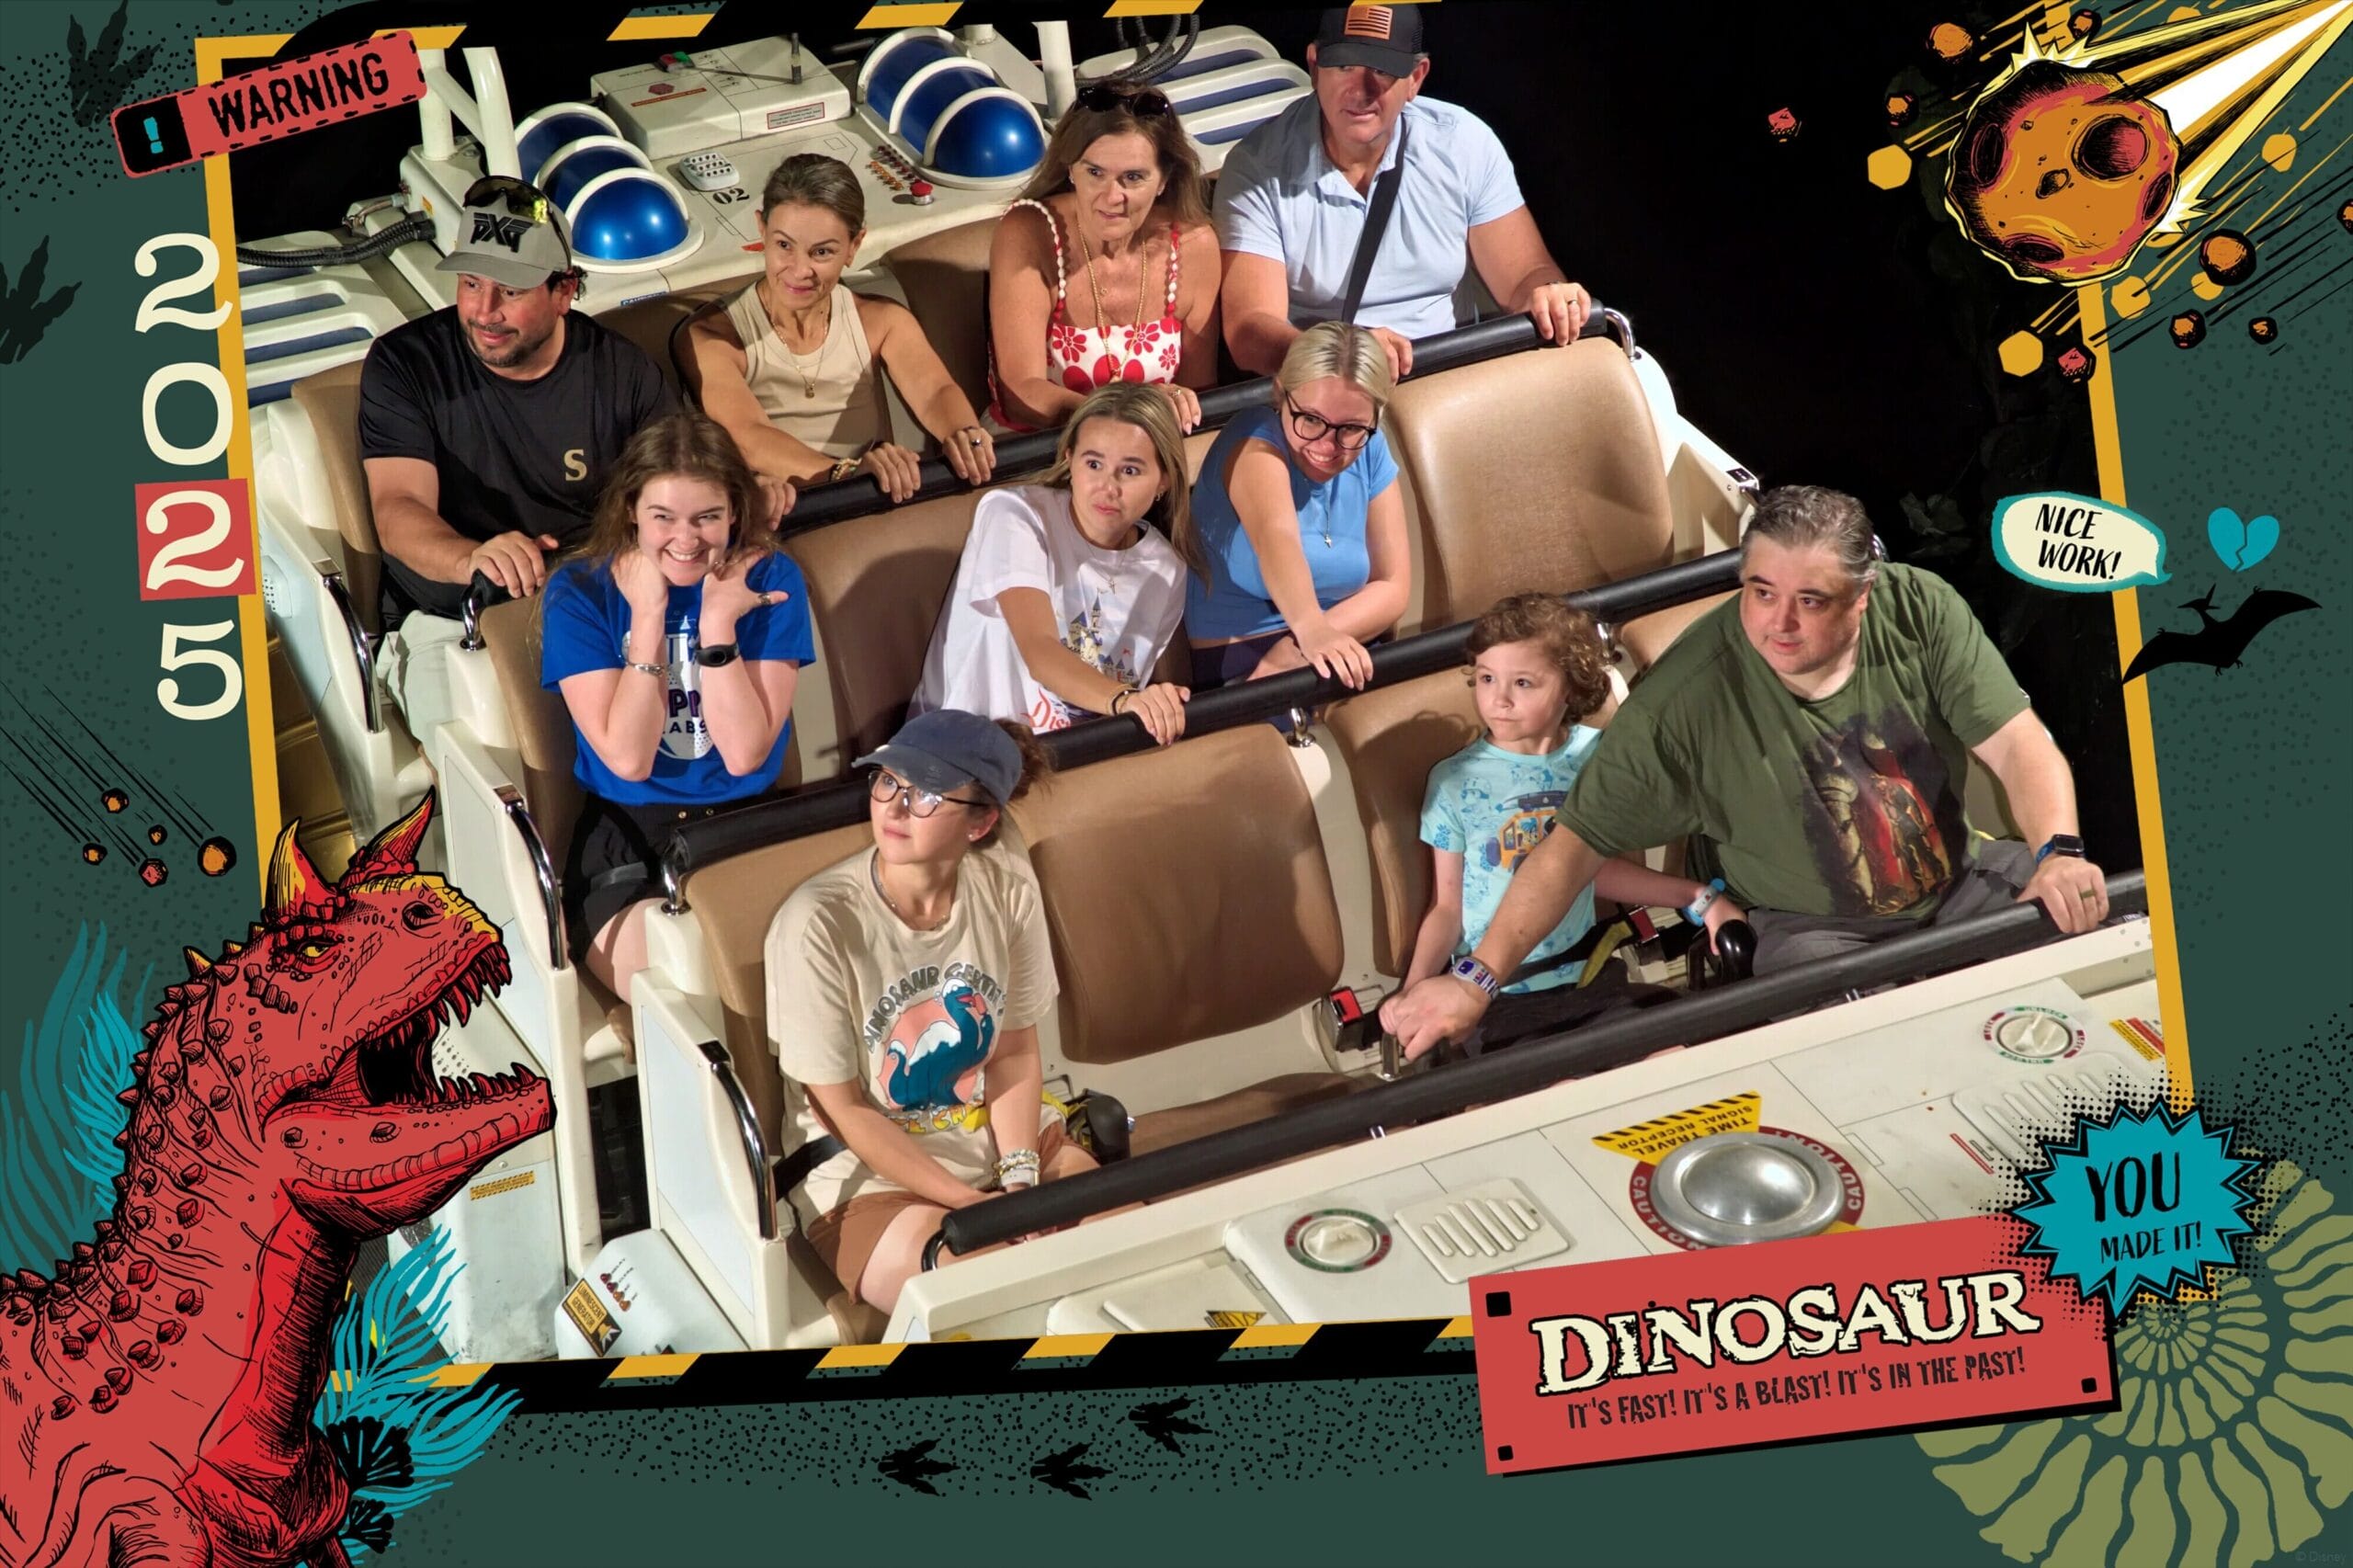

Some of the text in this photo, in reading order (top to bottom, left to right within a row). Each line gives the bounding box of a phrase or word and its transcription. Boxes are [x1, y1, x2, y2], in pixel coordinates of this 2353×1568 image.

[712, 187, 750, 204] 02
[563, 449, 587, 482] S
[1617, 1106, 1753, 1150] SIGNAL RECEPTOR
[1631, 1116, 1753, 1156] TIME TRAVEL
[571, 1296, 596, 1329] GENERATOR
[576, 1283, 605, 1321] LUMINESCENT
